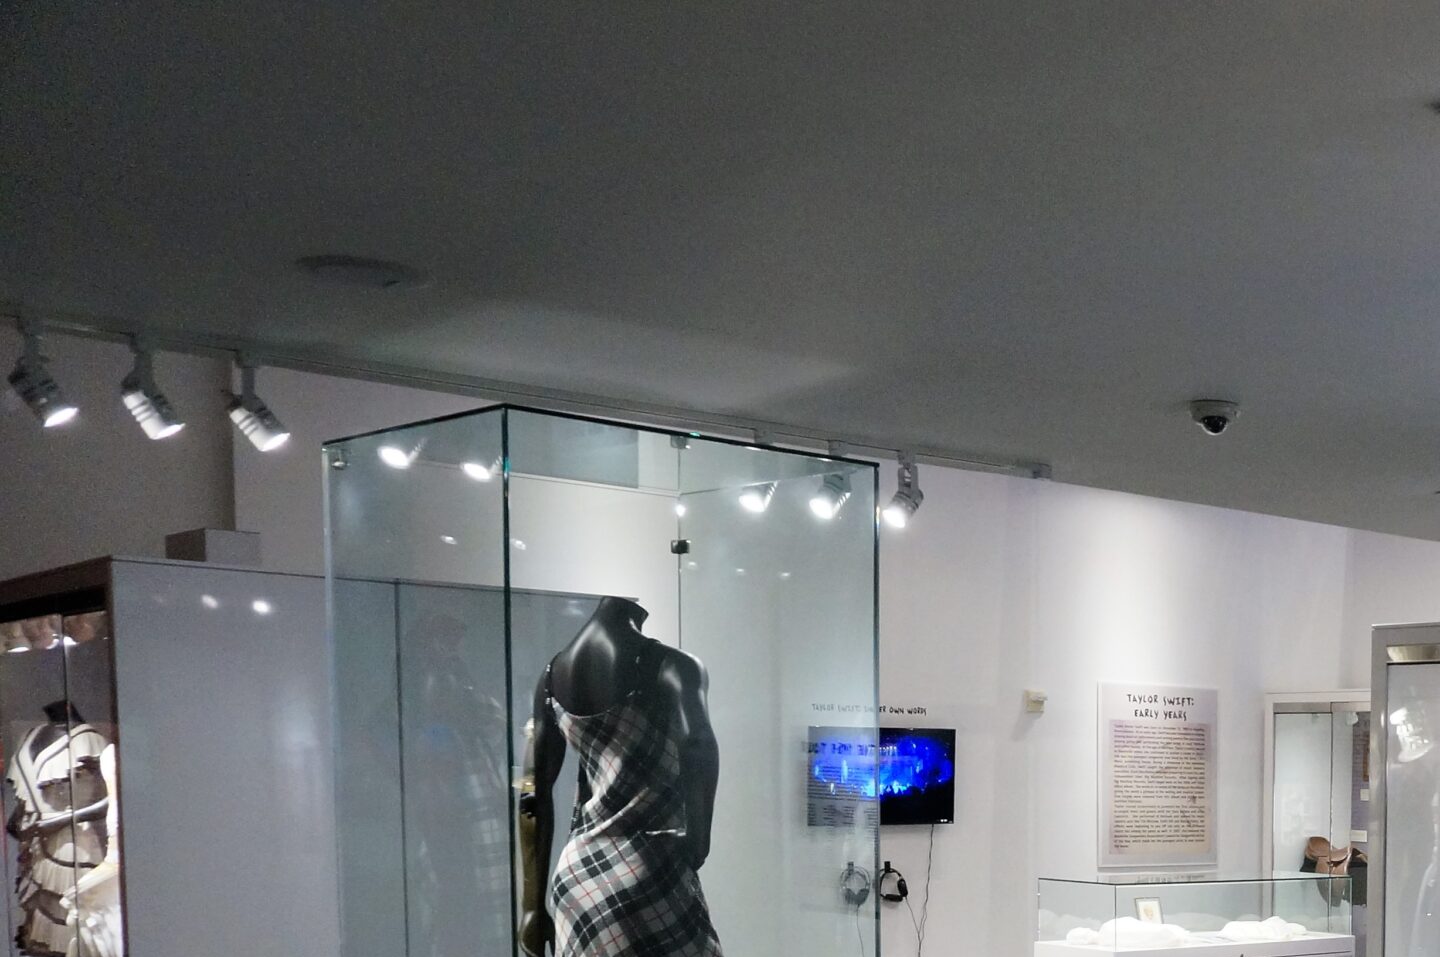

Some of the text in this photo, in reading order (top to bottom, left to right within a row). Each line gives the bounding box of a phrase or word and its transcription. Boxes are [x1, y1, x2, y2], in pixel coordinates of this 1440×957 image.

[1127, 694, 1195, 707] TAYLOR SWIFT:
[889, 706, 904, 715] OWN
[907, 706, 927, 716] WORDS
[1134, 708, 1187, 722] EARLY YEARS
